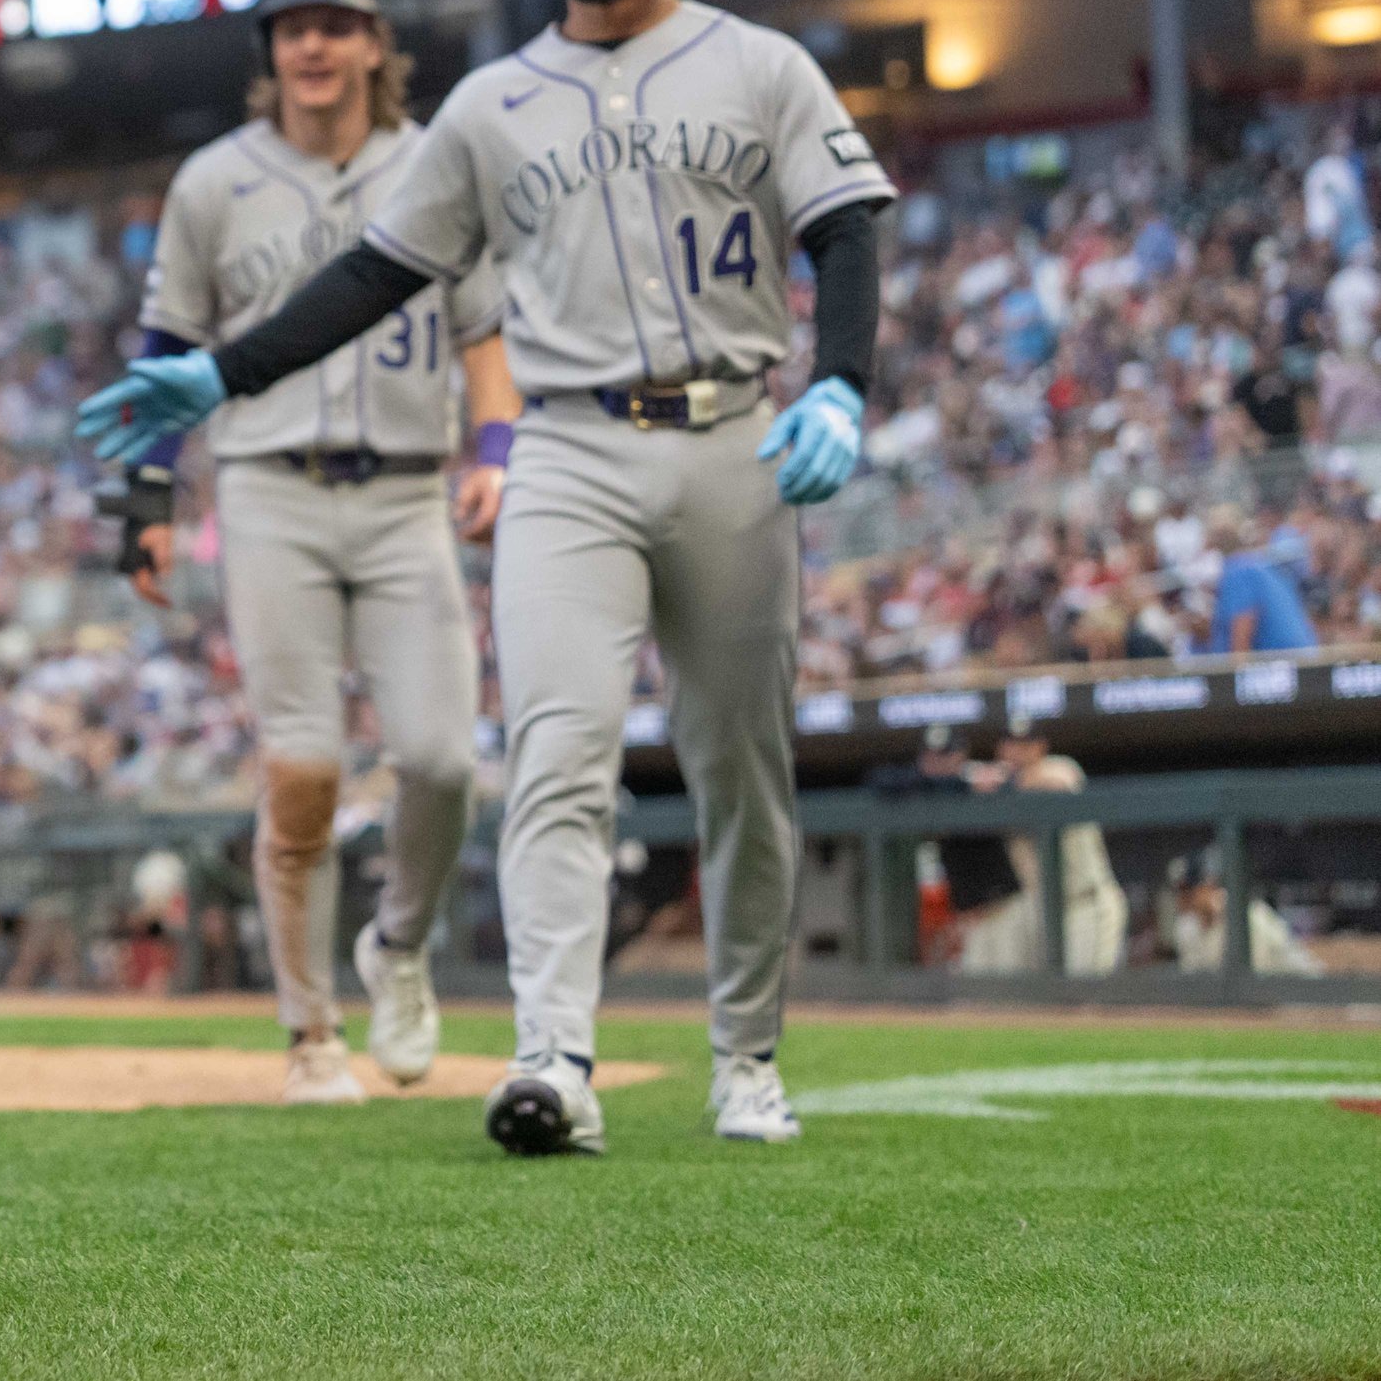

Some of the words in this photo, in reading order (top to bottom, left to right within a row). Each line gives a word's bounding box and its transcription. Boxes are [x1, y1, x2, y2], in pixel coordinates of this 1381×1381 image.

[500, 120, 771, 236] COLORADO
[676, 209, 758, 295] 14
[376, 306, 438, 373] 31
